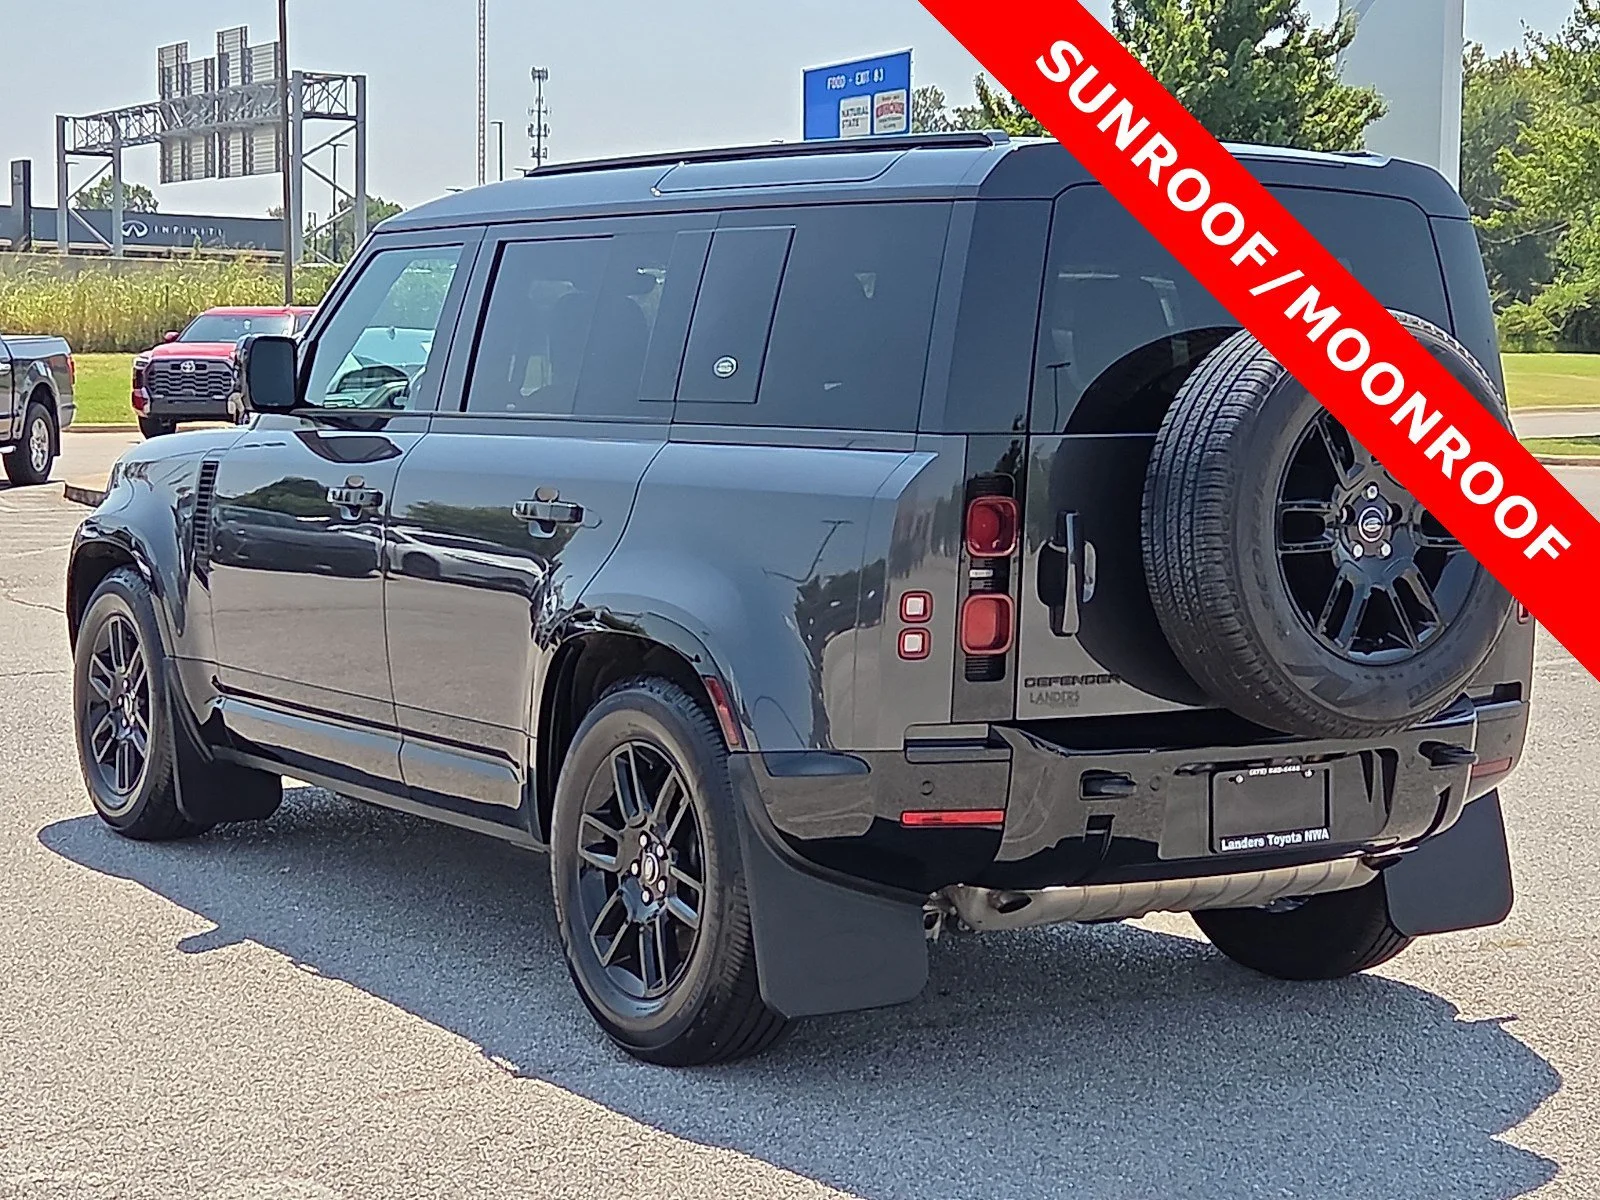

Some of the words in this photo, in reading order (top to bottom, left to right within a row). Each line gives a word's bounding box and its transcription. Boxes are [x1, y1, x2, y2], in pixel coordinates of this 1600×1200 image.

[827, 75, 846, 90] FOOD
[855, 70, 870, 85] EXIT
[841, 106, 869, 118] NATURAL
[841, 118, 859, 129] STATE
[153, 225, 223, 236] INFINITI
[1024, 674, 1121, 688] DEFENDER
[1030, 691, 1080, 704] LANDERS
[1221, 837, 1265, 851] Landers
[1267, 831, 1302, 847] Toyota
[1304, 828, 1330, 842] NWA
